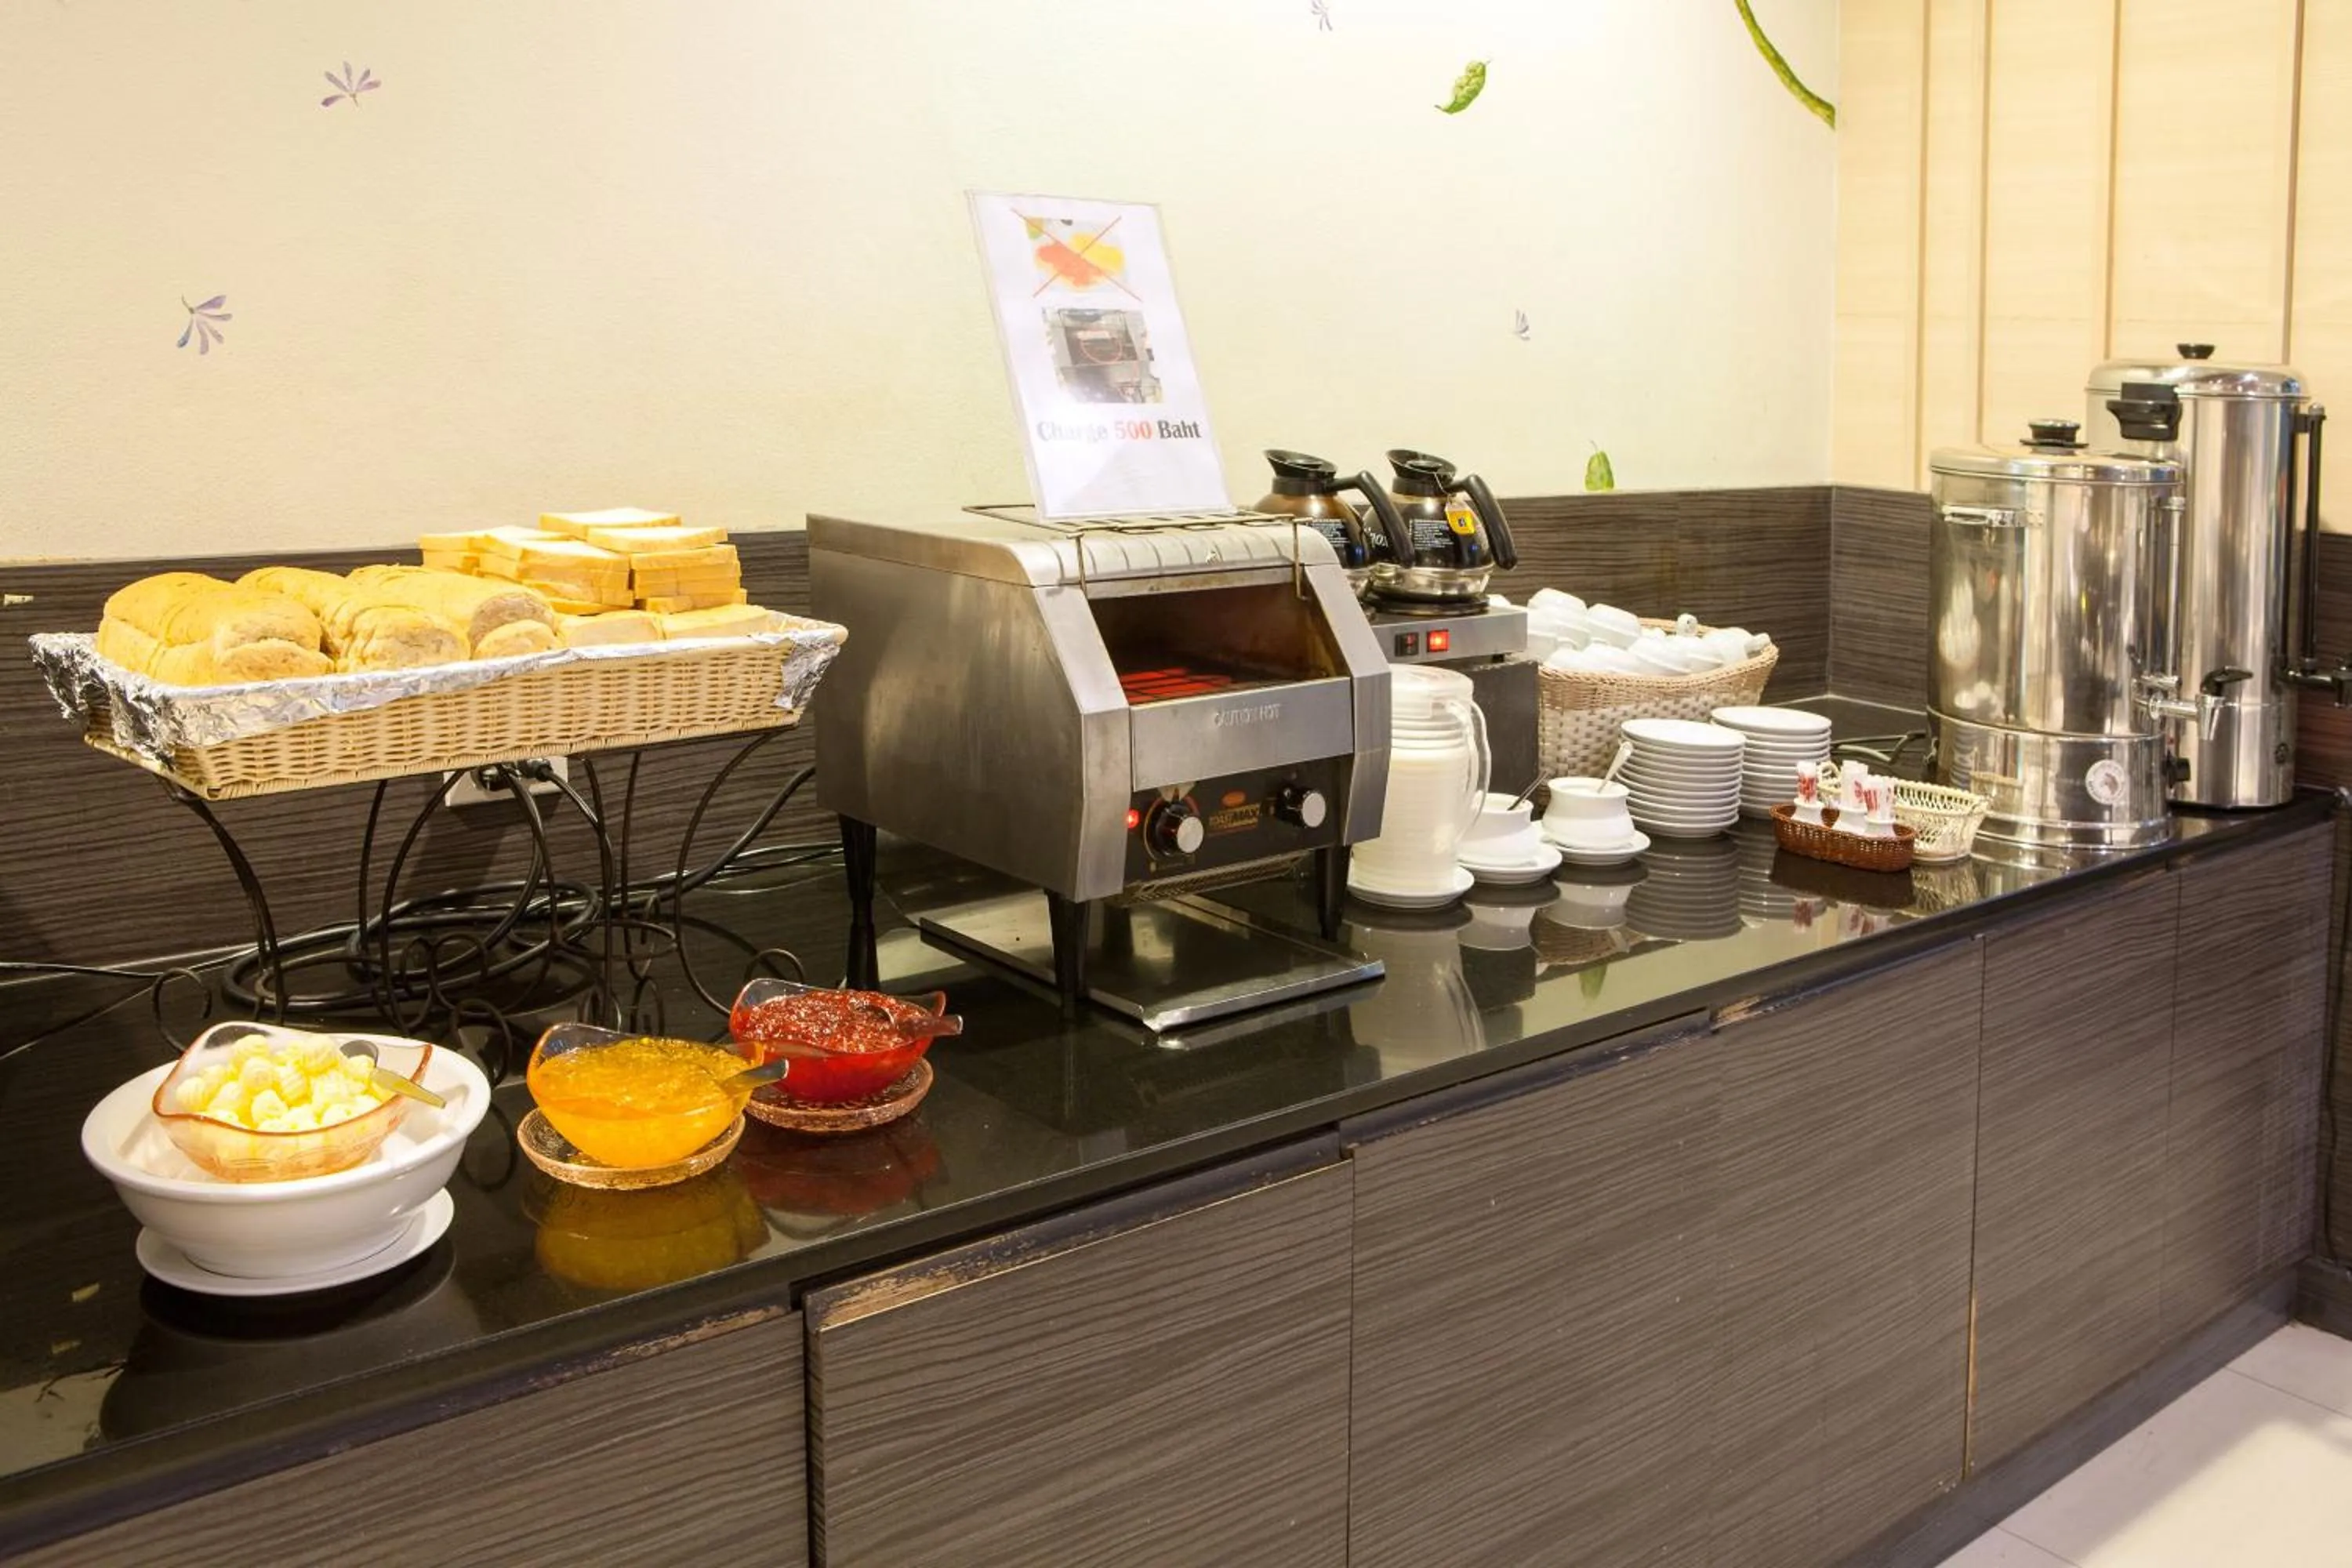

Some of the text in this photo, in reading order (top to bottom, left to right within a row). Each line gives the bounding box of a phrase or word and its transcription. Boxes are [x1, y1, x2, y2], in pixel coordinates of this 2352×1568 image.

[1036, 419, 1202, 444] Charge 500 Baht
